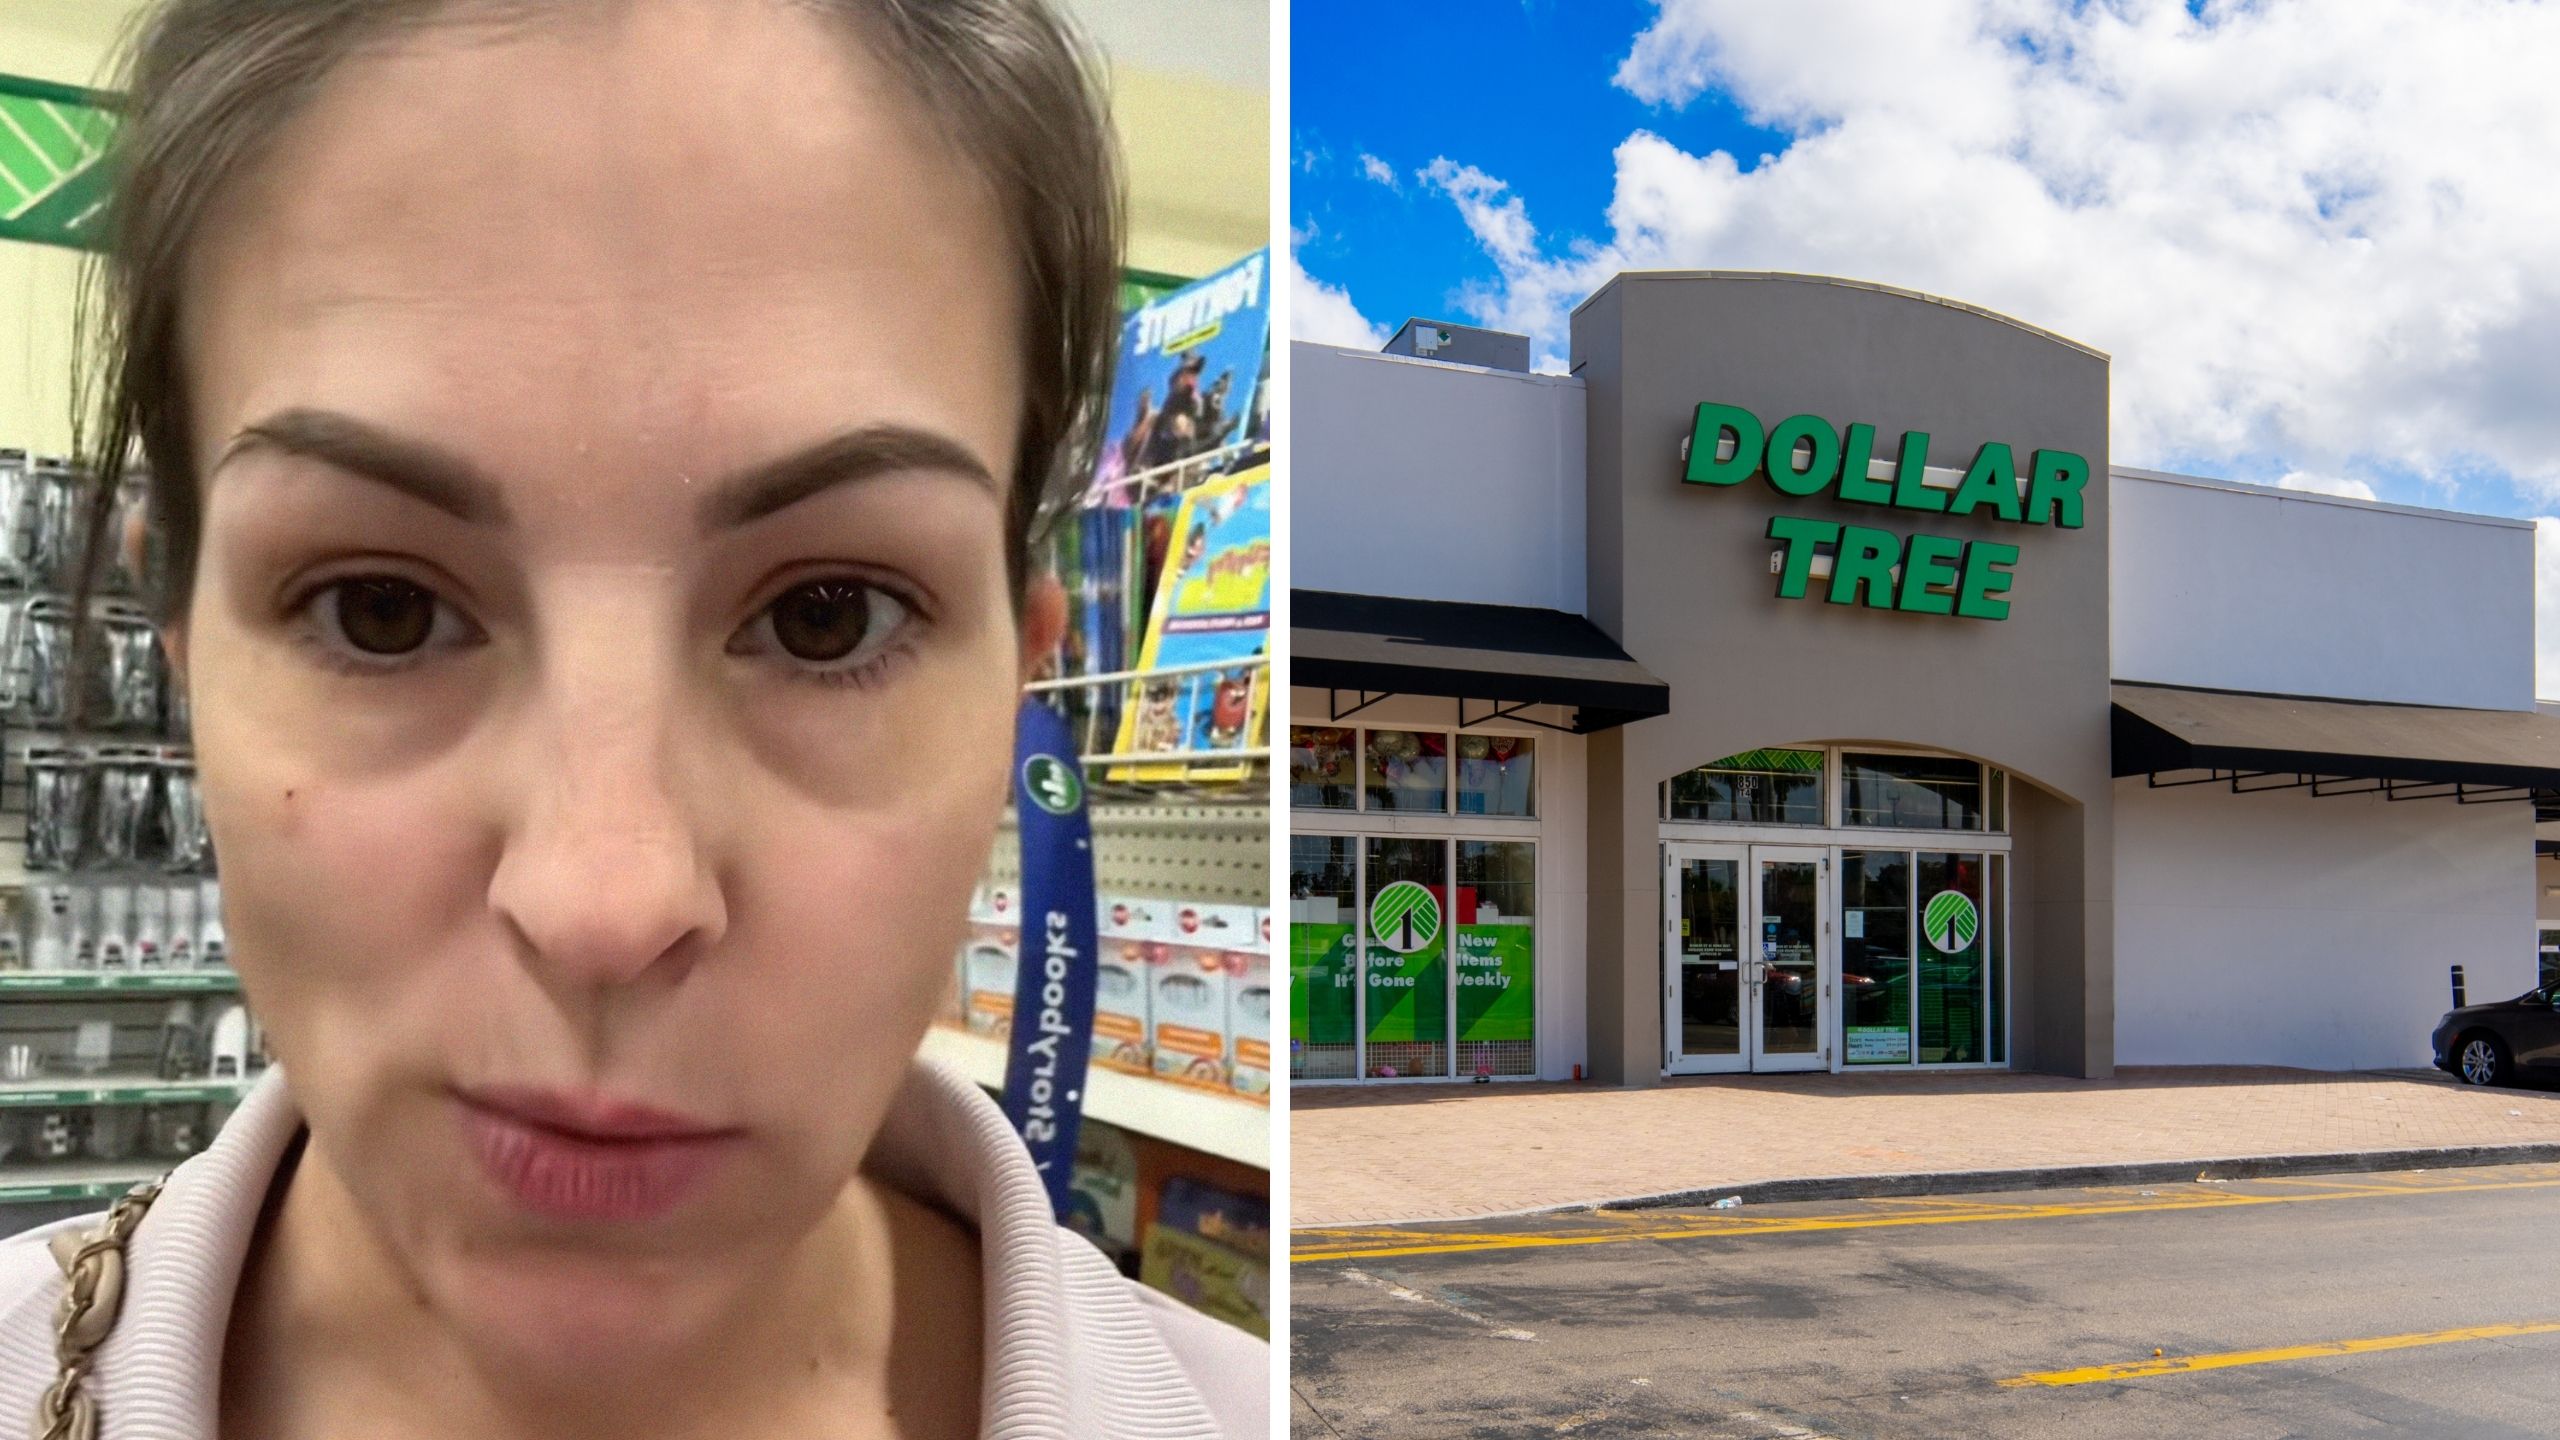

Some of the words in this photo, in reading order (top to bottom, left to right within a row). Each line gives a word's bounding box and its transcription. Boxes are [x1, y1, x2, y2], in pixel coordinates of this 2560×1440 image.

[1682, 402, 2090, 529] DOLLAR
[1765, 516, 2020, 621] TREE
[1738, 776, 1758, 788] 850
[1459, 933, 1498, 947] New
[1344, 952, 1405, 967] Bfore
[1456, 953, 1503, 967] Items
[1334, 973, 1356, 987] It'
[1368, 973, 1415, 987] Gone
